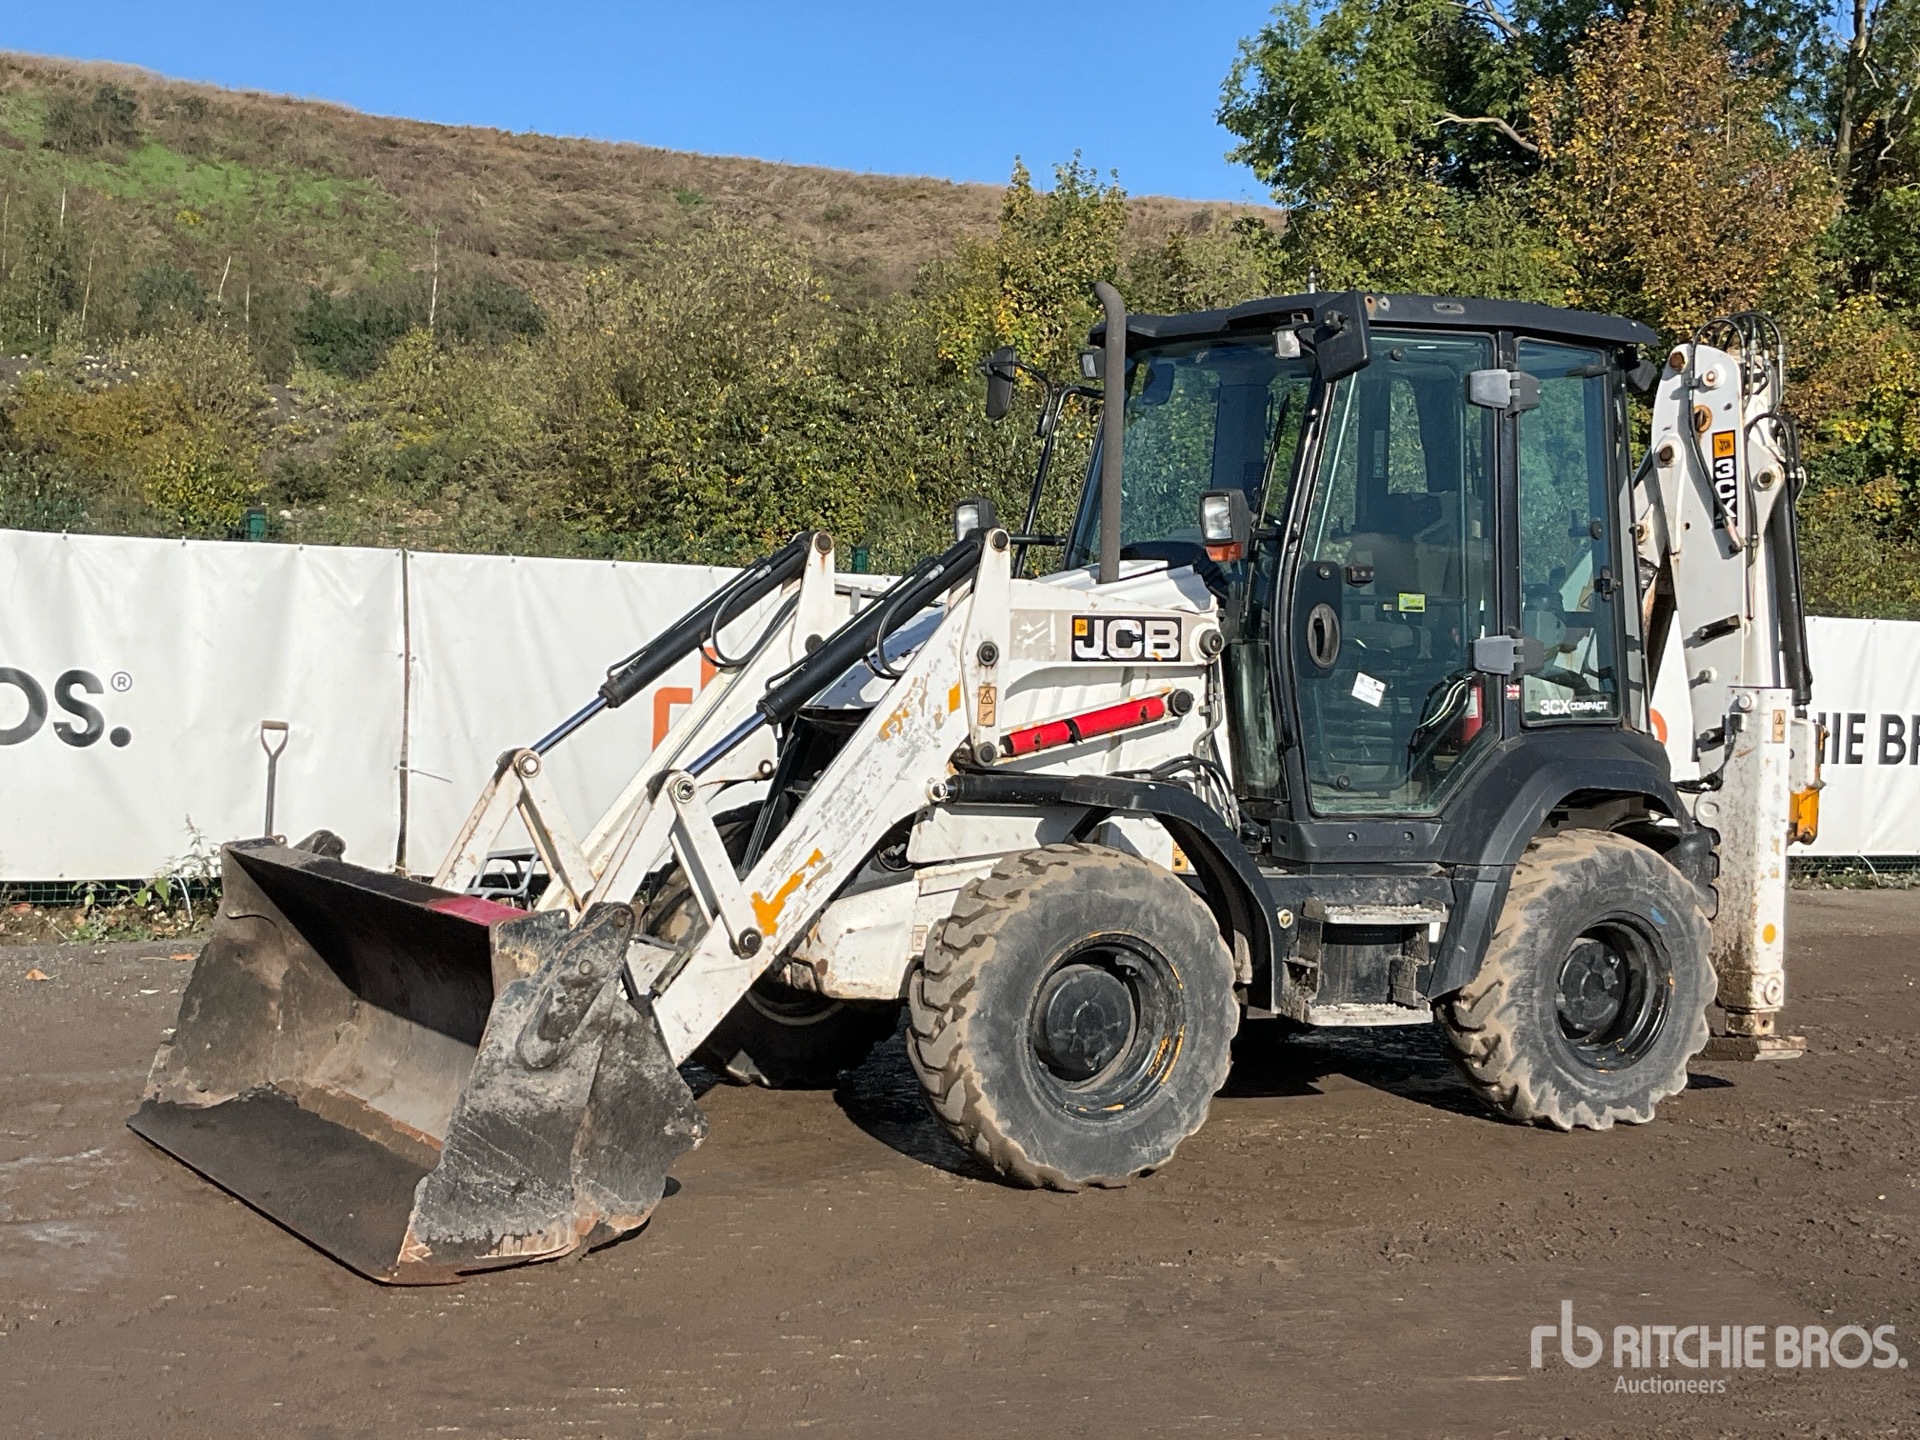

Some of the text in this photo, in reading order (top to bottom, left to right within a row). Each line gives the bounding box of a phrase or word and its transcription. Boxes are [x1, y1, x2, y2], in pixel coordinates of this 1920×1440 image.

[1074, 619, 1179, 659] JCB
[1540, 699, 1608, 715] 3CX COMPACT
